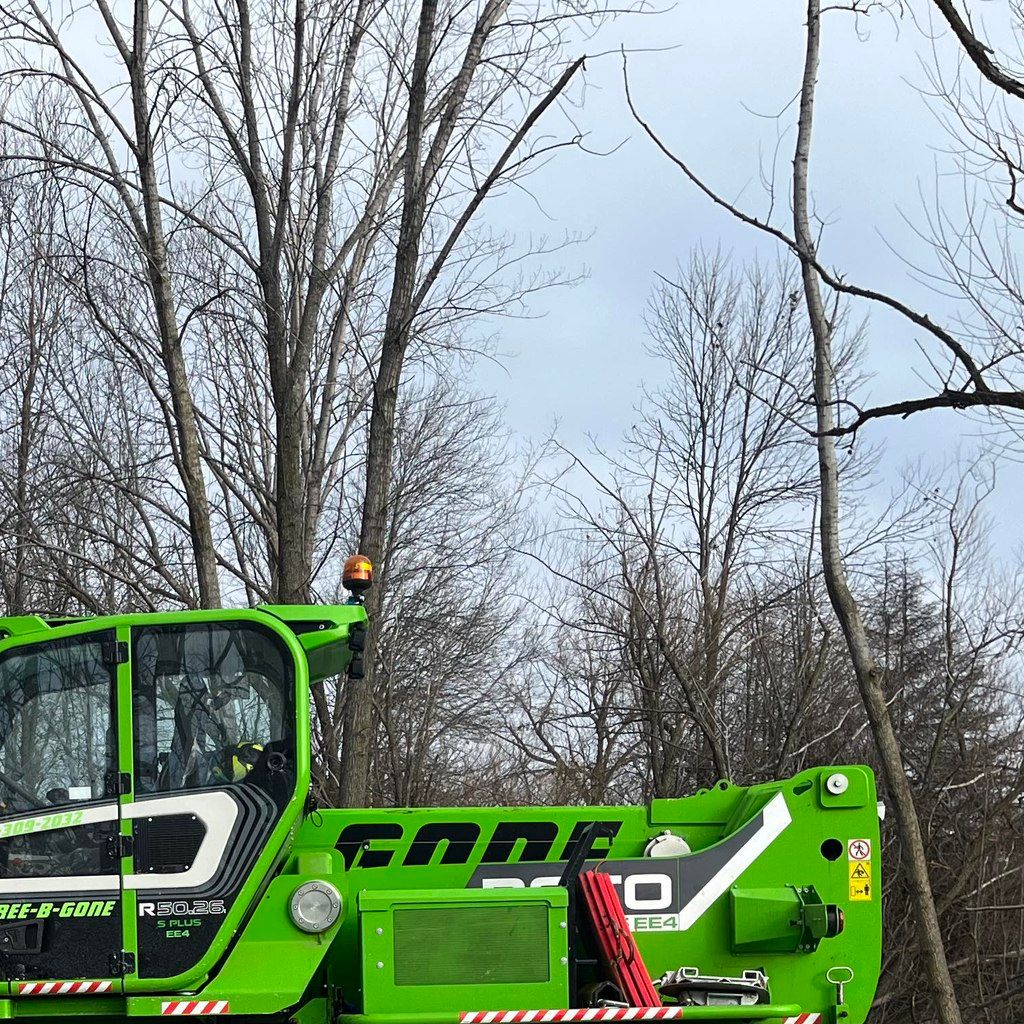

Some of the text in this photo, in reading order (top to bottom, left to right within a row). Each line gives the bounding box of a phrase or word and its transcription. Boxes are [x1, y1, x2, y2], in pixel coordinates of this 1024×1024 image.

[157, 919, 202, 928] S PLUS
[634, 916, 677, 929] EE4
[166, 930, 190, 938] EE4
